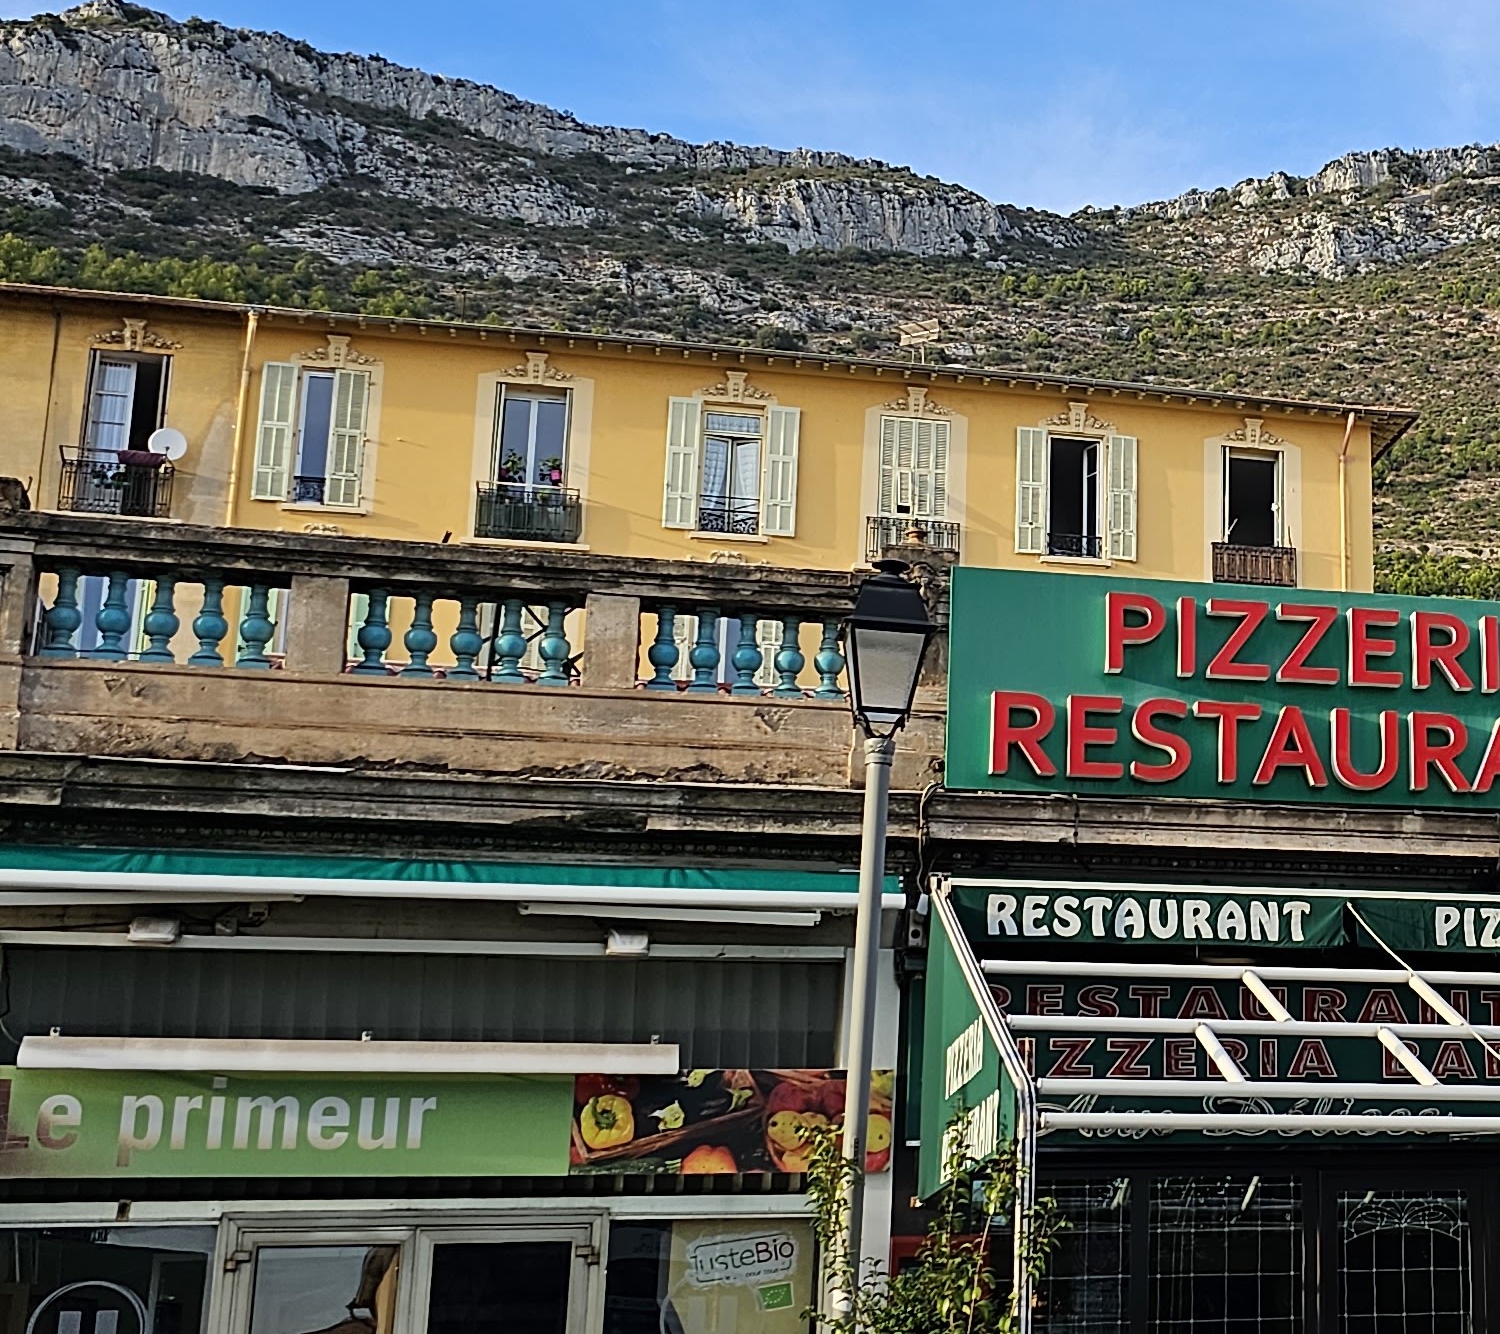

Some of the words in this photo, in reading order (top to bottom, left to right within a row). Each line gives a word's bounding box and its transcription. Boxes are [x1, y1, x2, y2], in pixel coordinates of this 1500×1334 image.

[986, 893, 1311, 942] RESTAURANT
[1016, 1037, 1338, 1079] IZZERIA
[0, 1079, 83, 1151] Le
[116, 1075, 438, 1168] primeur
